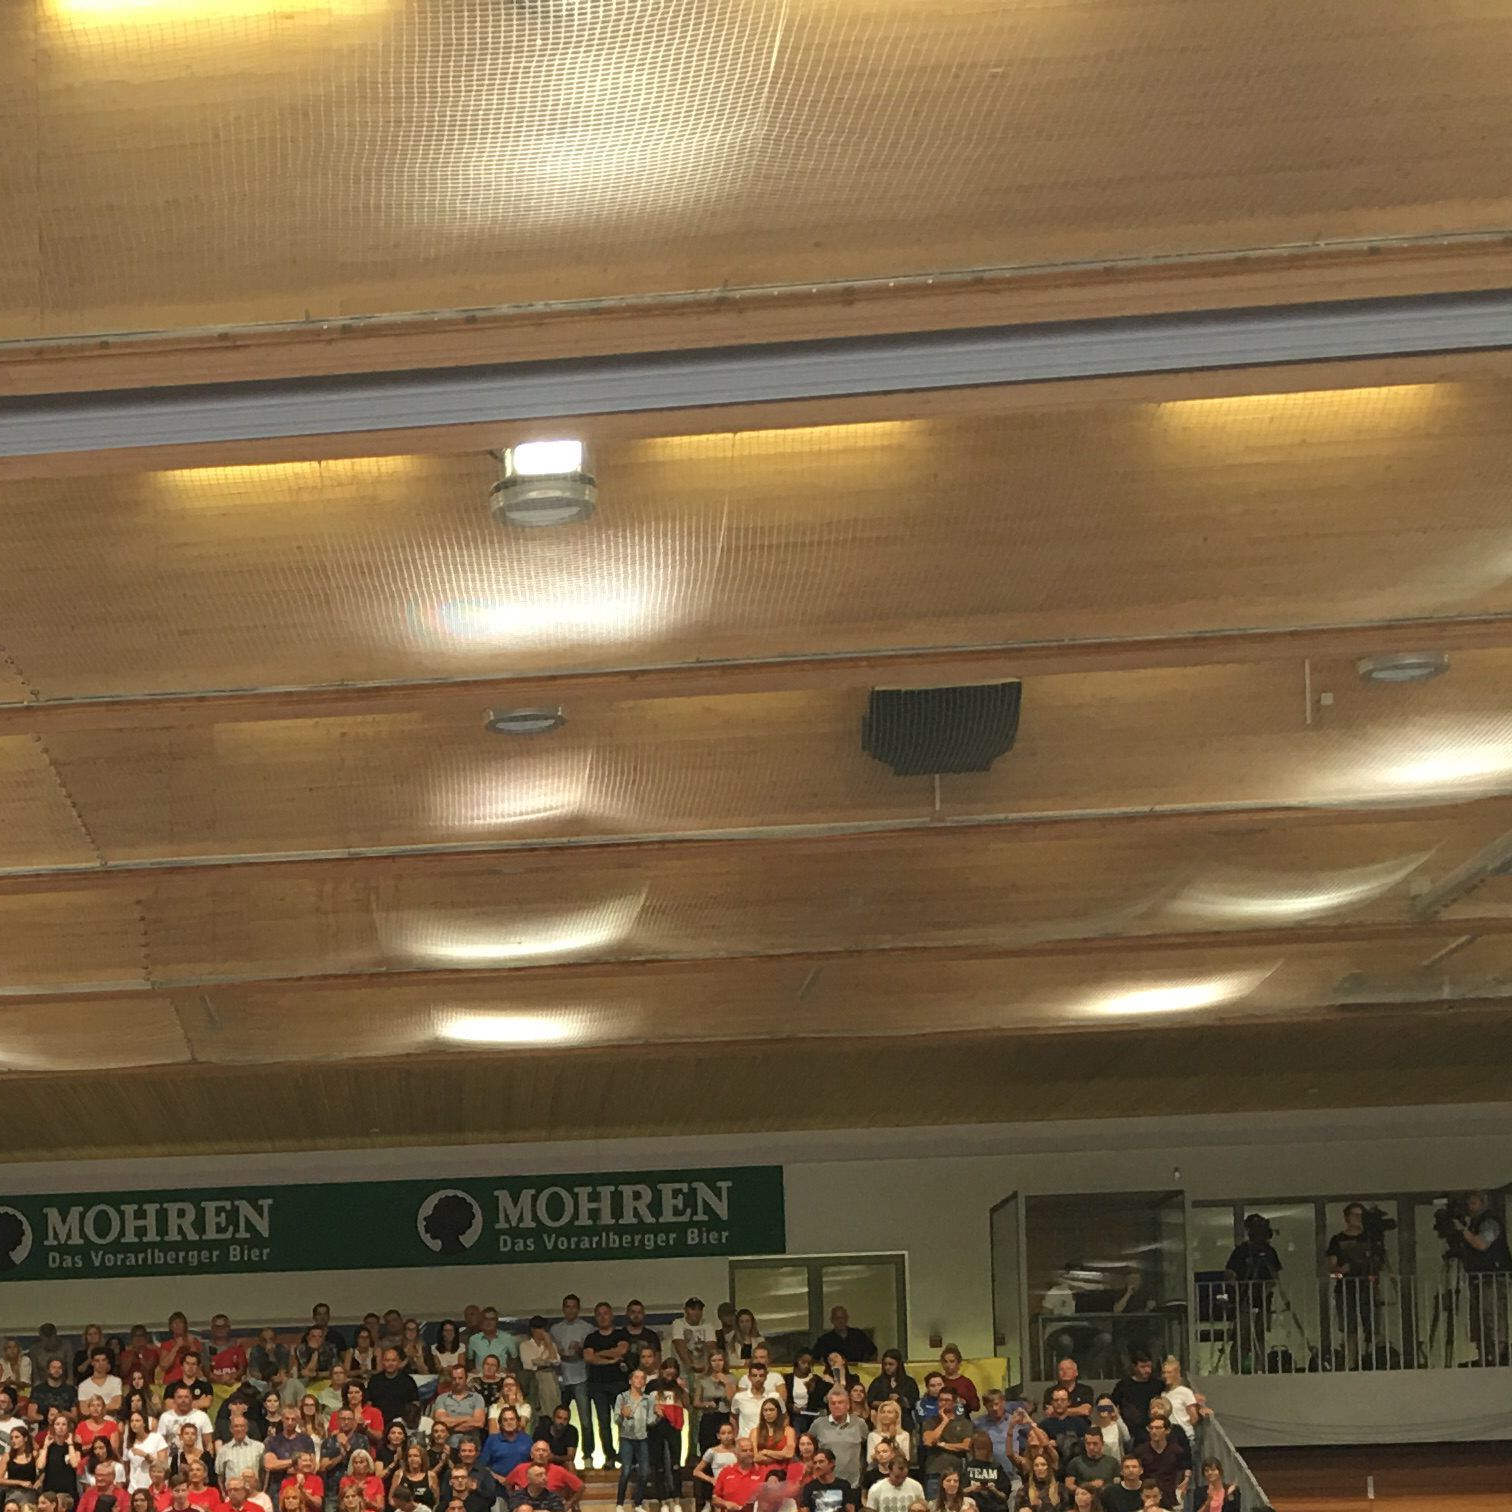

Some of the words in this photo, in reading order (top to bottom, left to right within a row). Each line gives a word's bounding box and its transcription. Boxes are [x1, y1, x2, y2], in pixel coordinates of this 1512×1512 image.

[494, 1182, 731, 1229] MOHREN
[44, 1199, 273, 1246] MOHREN
[499, 1235, 535, 1251] Das
[544, 1229, 677, 1250] Vorarlberger
[687, 1228, 730, 1245] Bier
[49, 1252, 84, 1268] Das
[92, 1247, 220, 1267] Vorarlberger
[229, 1245, 271, 1261] Bier
[967, 1467, 998, 1480] TEAM
